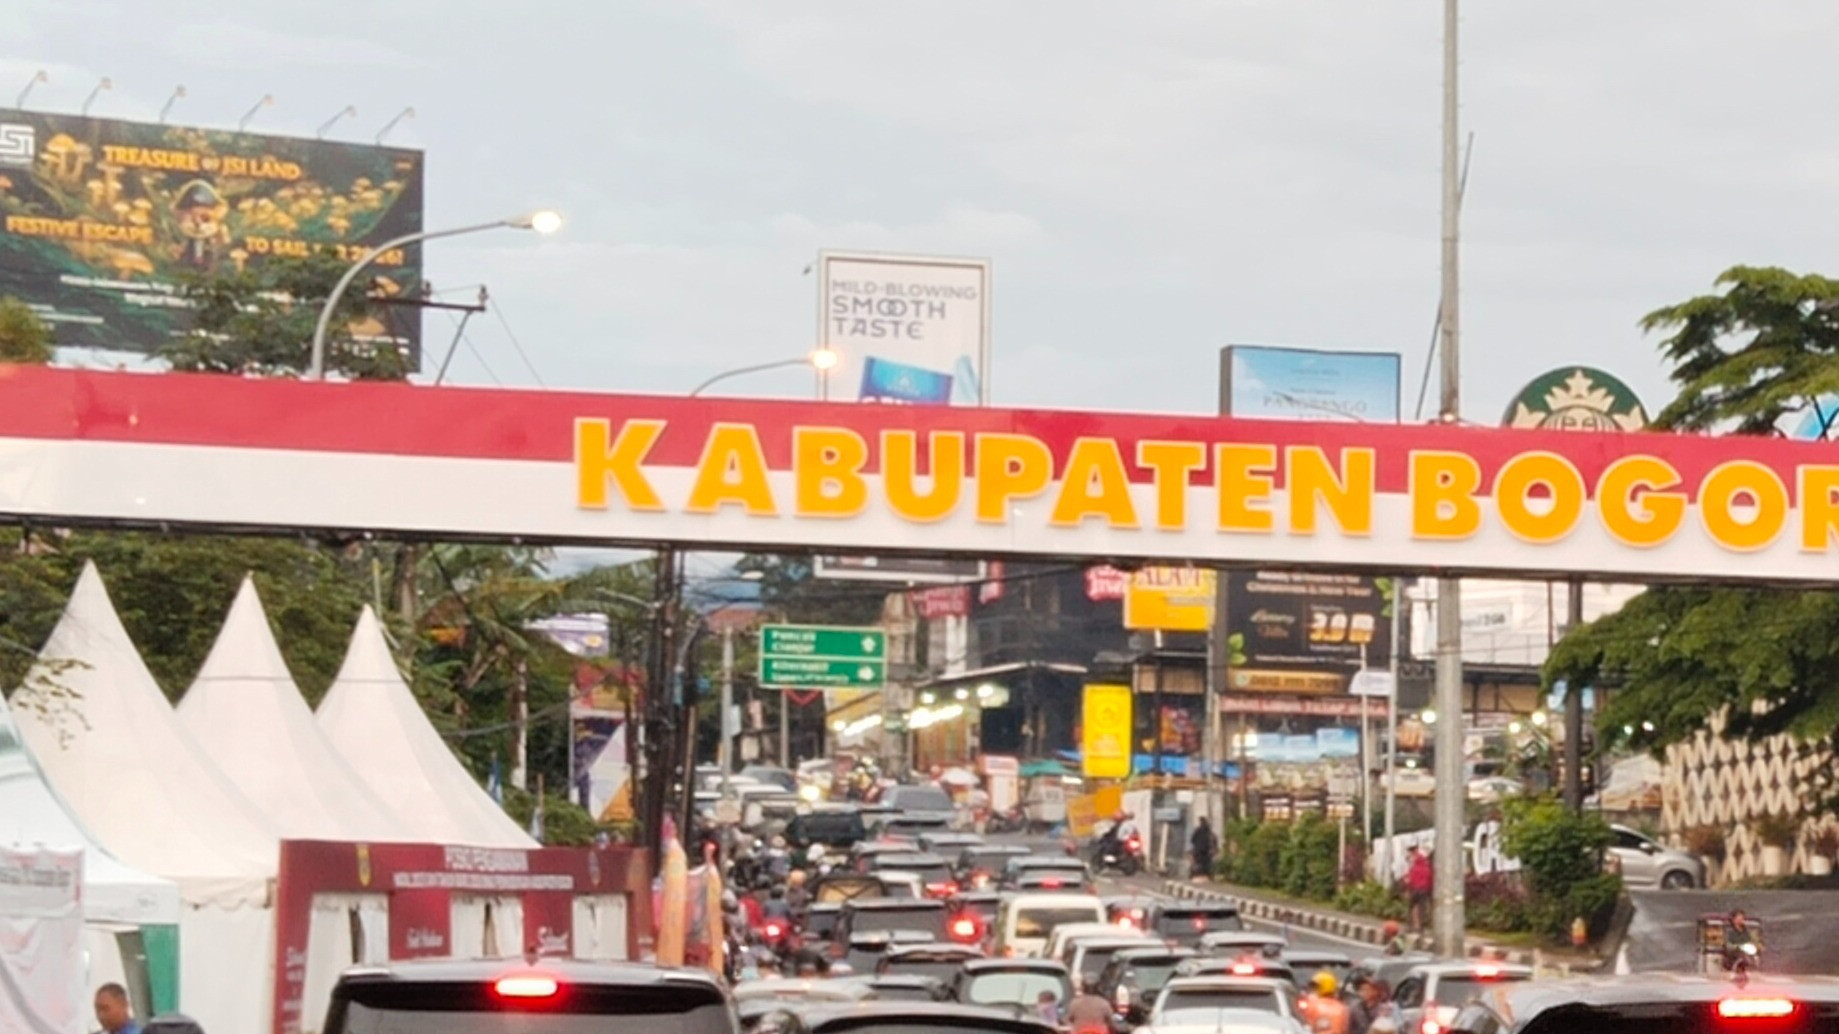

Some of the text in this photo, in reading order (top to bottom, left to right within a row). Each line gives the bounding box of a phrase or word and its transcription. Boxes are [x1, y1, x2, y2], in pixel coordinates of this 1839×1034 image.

[104, 145, 199, 172] TREASURE
[250, 158, 301, 181] LAND
[6, 215, 153, 244] FESTIVE ESCAPE
[246, 236, 269, 254] TO
[832, 280, 977, 300] MILD-BLOWING
[832, 295, 947, 320] SMOOTH
[832, 316, 925, 340] TASTE
[574, 416, 1377, 538] KABUPATEN
